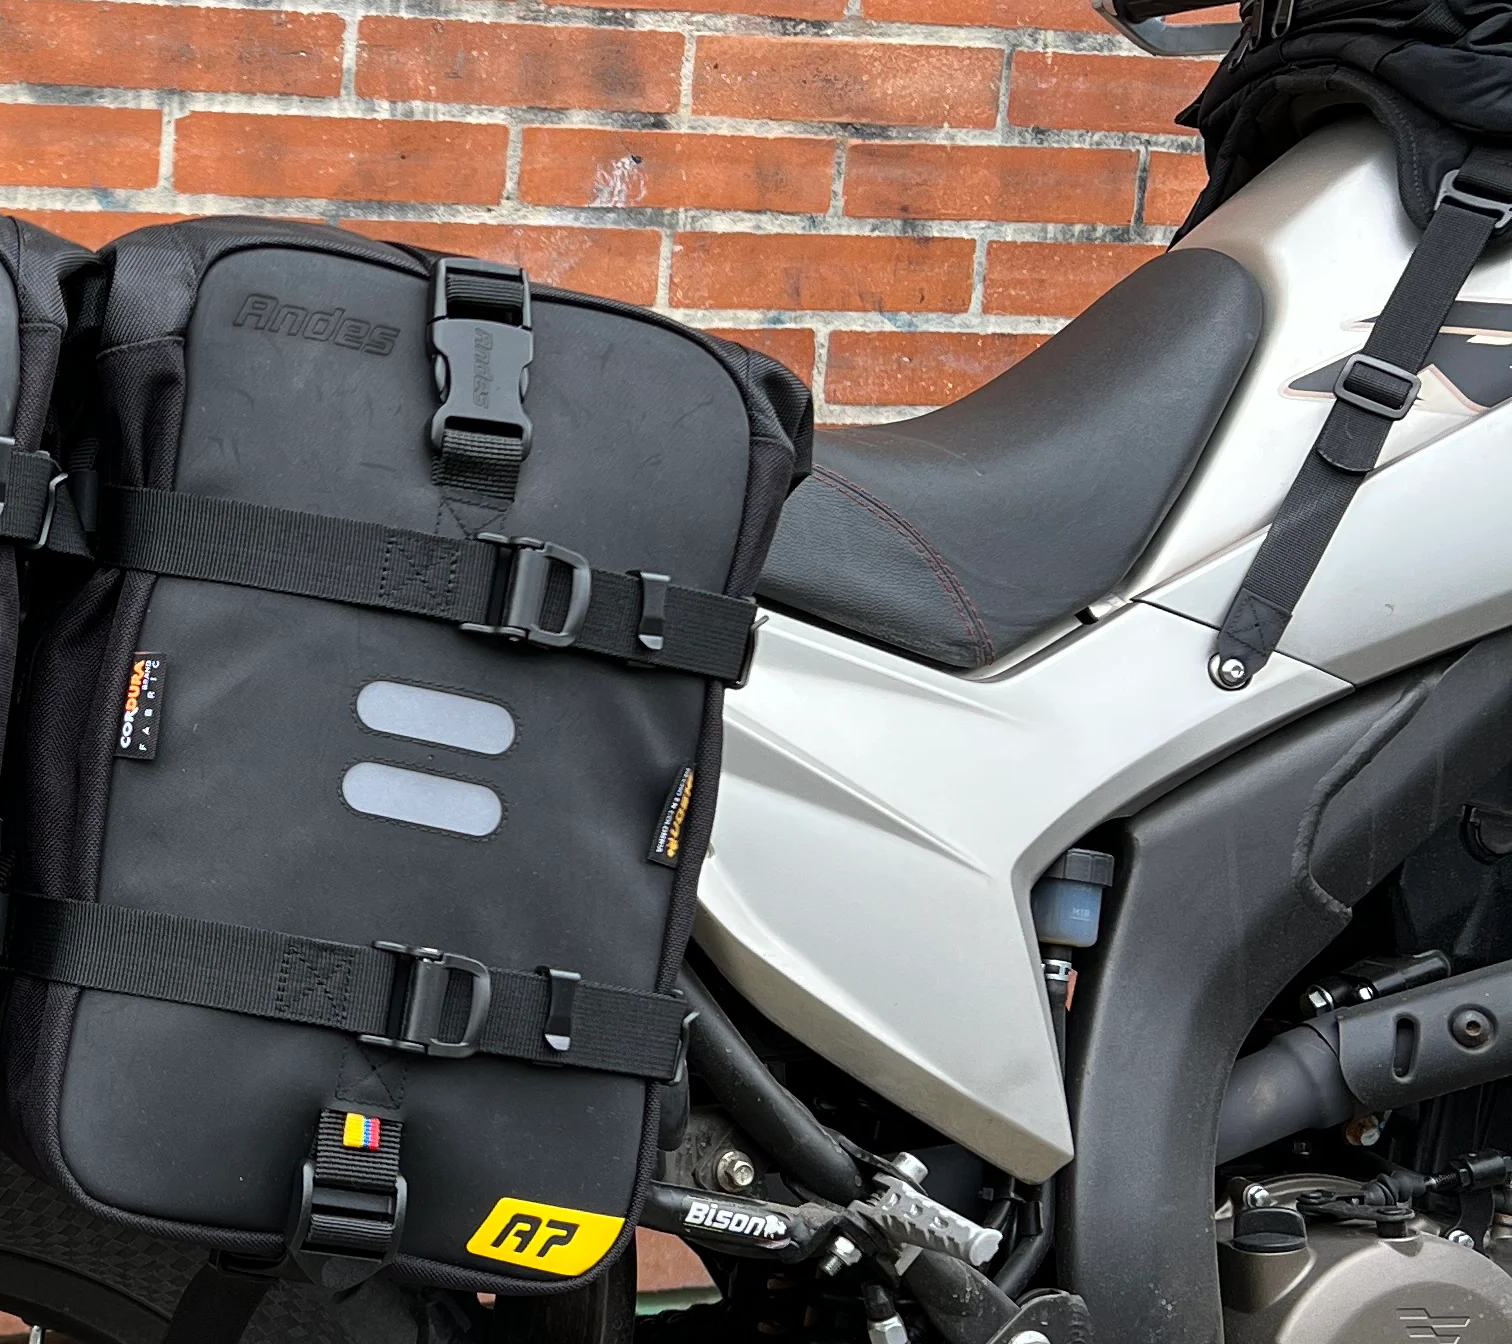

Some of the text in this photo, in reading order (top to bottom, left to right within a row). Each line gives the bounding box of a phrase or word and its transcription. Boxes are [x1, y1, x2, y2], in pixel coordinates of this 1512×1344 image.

[233, 293, 400, 356] Andes
[473, 327, 494, 409] Andes
[120, 660, 152, 749] CORDURA BRAND
[684, 1201, 767, 1238] Bison
